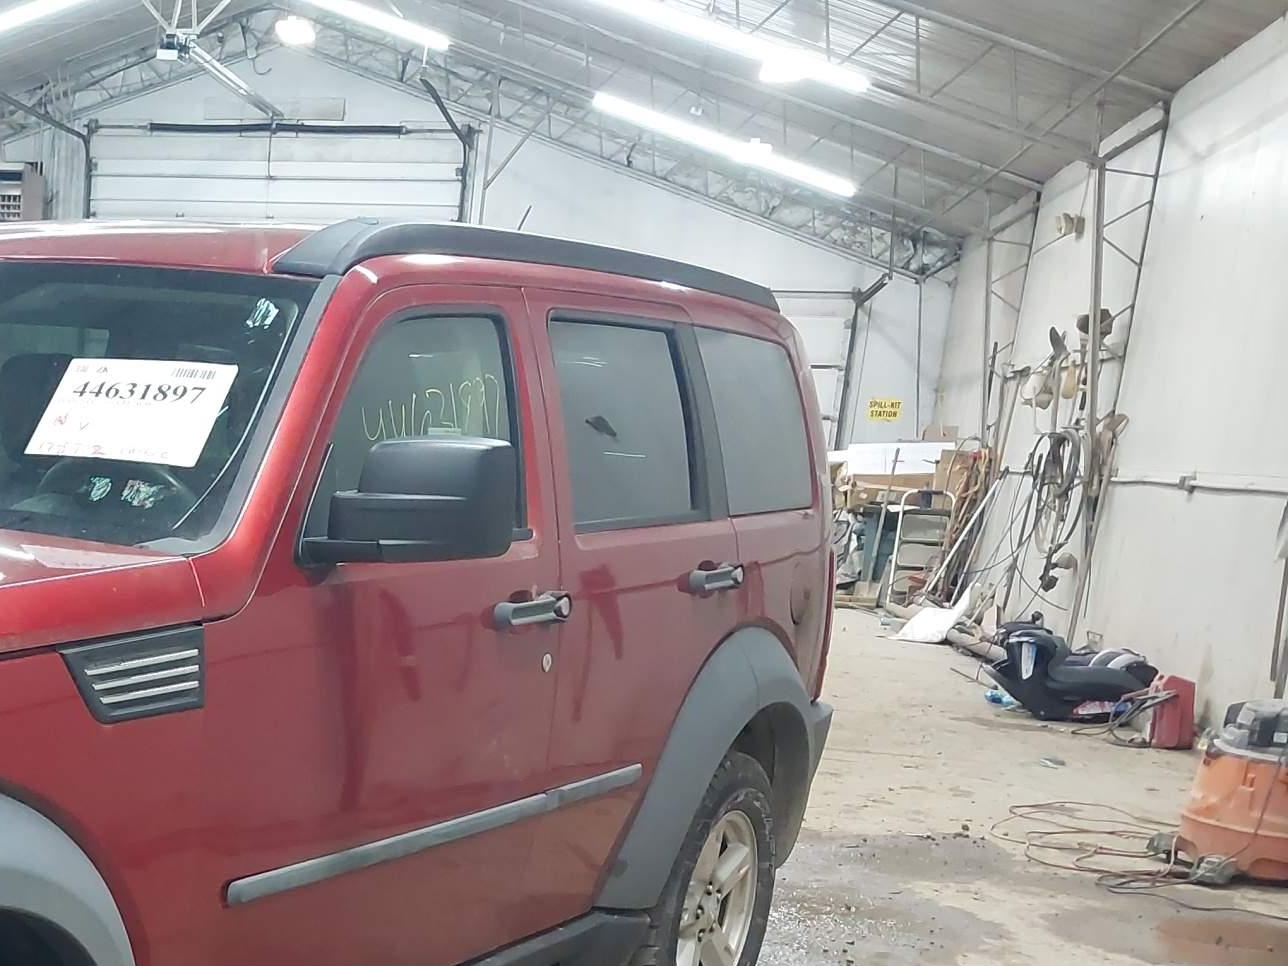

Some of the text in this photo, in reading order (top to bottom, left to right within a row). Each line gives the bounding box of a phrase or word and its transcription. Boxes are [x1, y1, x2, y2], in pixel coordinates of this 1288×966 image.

[71, 380, 206, 405] 44631897
[869, 400, 901, 409] SPILL-KIT
[870, 410, 898, 418] STATION
